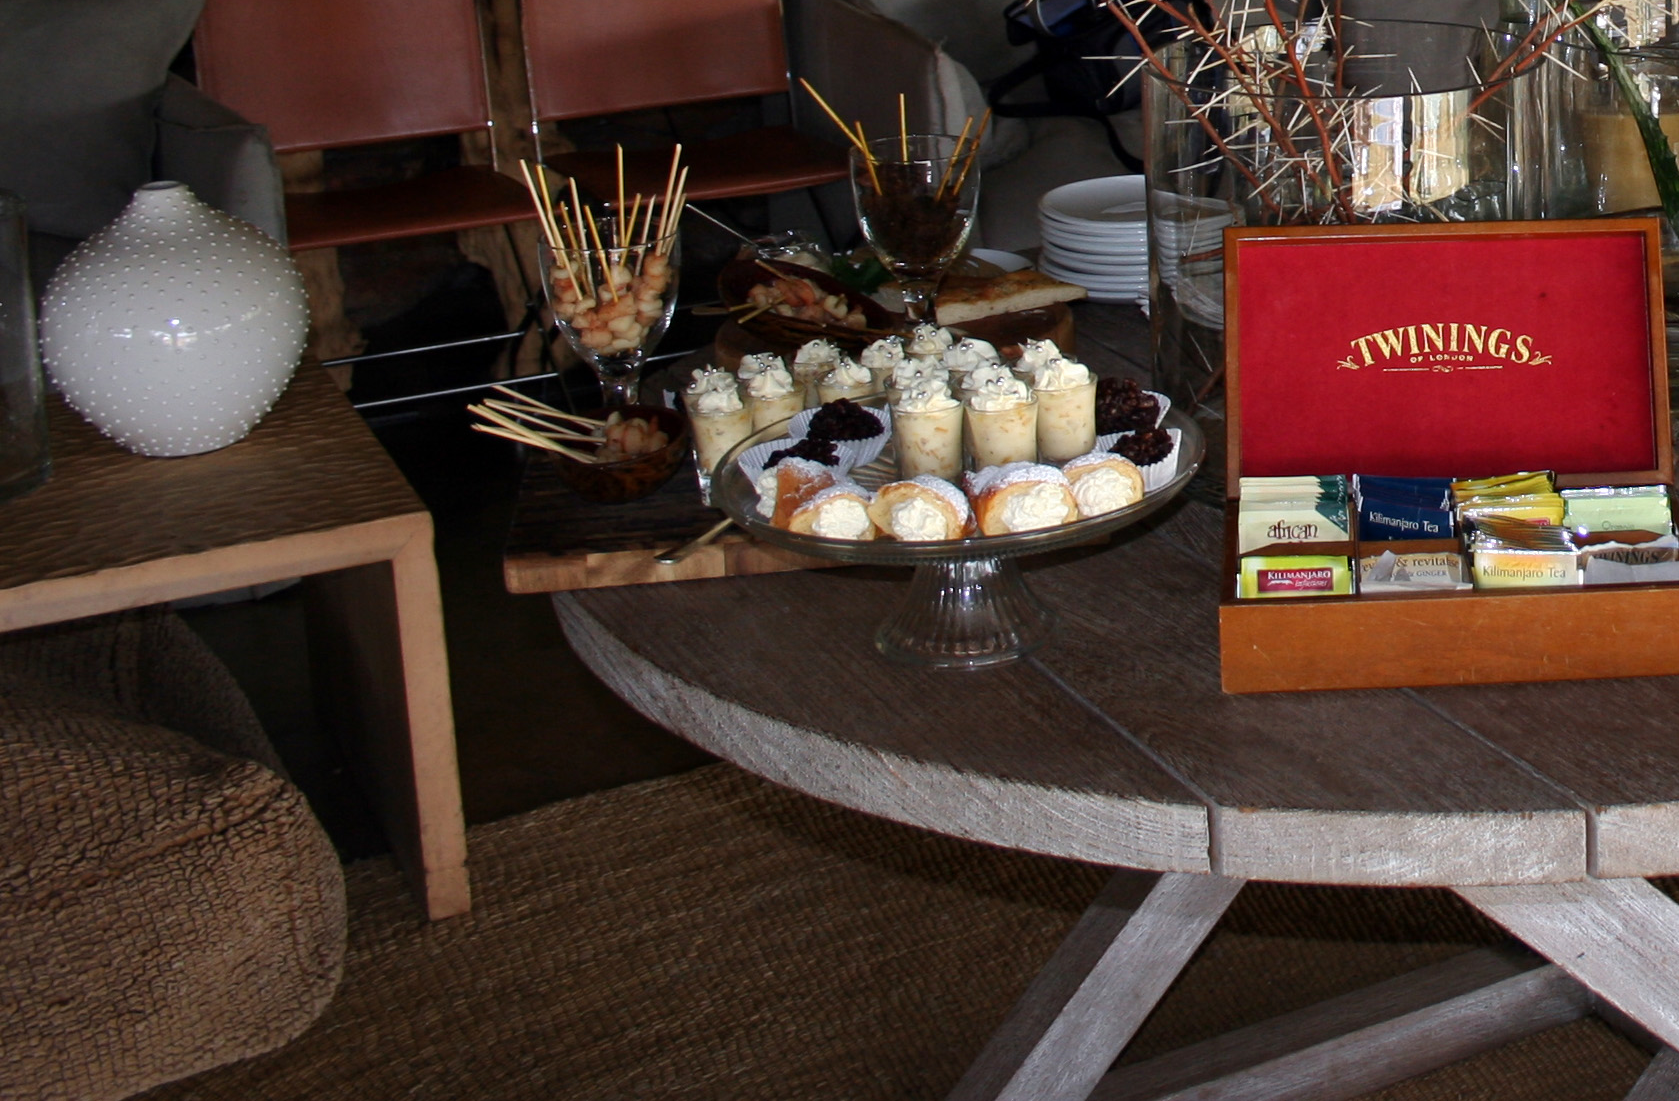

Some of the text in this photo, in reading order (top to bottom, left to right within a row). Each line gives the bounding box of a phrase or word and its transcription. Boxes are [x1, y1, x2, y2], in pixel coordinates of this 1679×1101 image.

[1350, 323, 1534, 367] TWININGS
[1410, 353, 1474, 364] OF LONDON
[1267, 519, 1318, 540] african
[1369, 511, 1439, 533] Kilimanjaro Tea
[1267, 570, 1332, 580] KILIMANJARO
[1483, 565, 1566, 581] Kilimanjaro Tea
